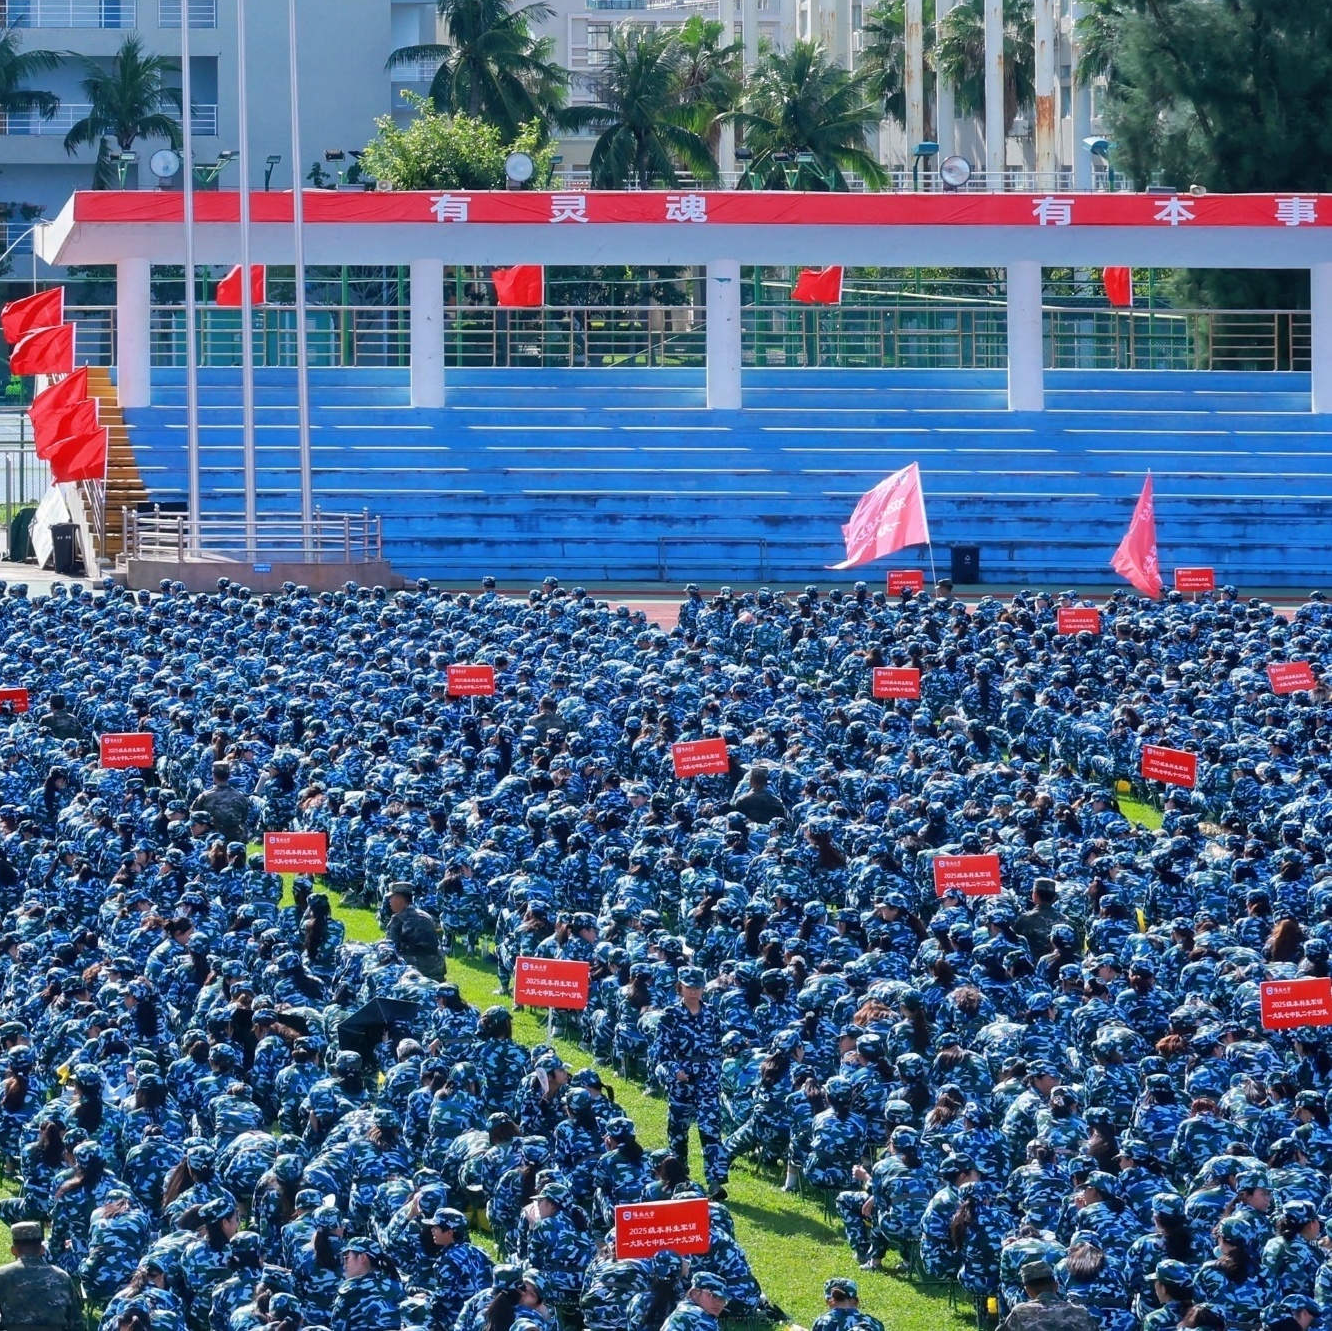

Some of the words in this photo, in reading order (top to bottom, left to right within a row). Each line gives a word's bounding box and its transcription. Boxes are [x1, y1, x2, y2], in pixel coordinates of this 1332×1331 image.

[430, 194, 708, 223] 有灵魂
[1032, 197, 1318, 226] 有本事
[526, 978, 578, 987] 2025级本科生军训
[519, 989, 582, 999] 一大队七中队二十八分队
[1272, 998, 1323, 1008] 2025级本科生军训
[1266, 1009, 1328, 1019] 一大队七中队二十三分队
[629, 1223, 696, 1235] 2025级本科生军训
[622, 1235, 703, 1247] 一大队七中队二十九分队
